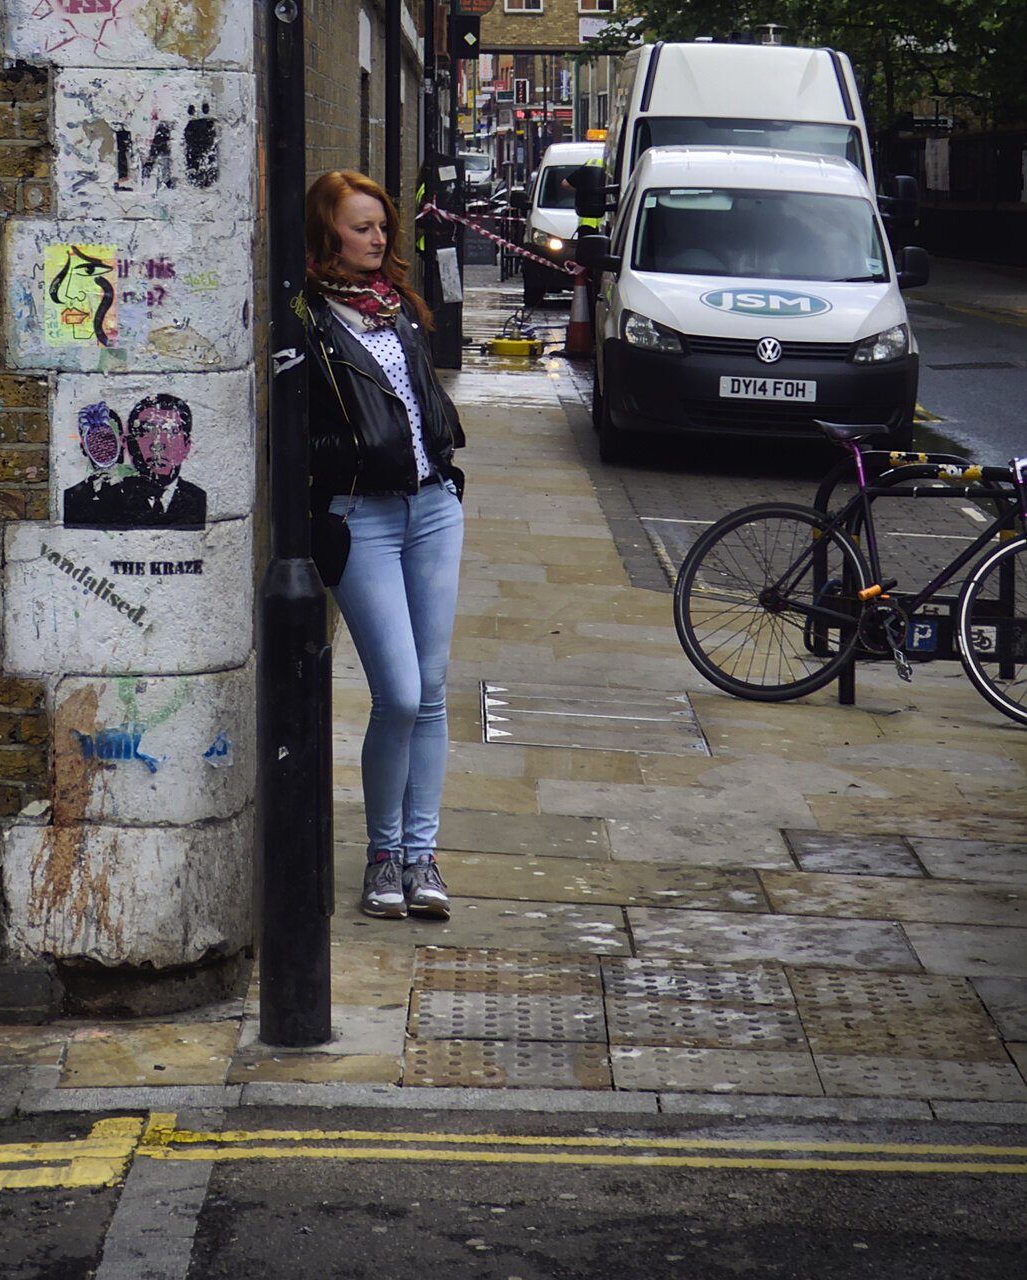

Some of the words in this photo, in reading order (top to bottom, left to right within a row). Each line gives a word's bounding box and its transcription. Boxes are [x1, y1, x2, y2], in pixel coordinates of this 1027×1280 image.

[717, 292, 811, 312] JSM
[730, 378, 768, 396] DY14
[773, 381, 806, 398] FOH
[110, 560, 146, 575] THE
[149, 559, 203, 576] KRAZE
